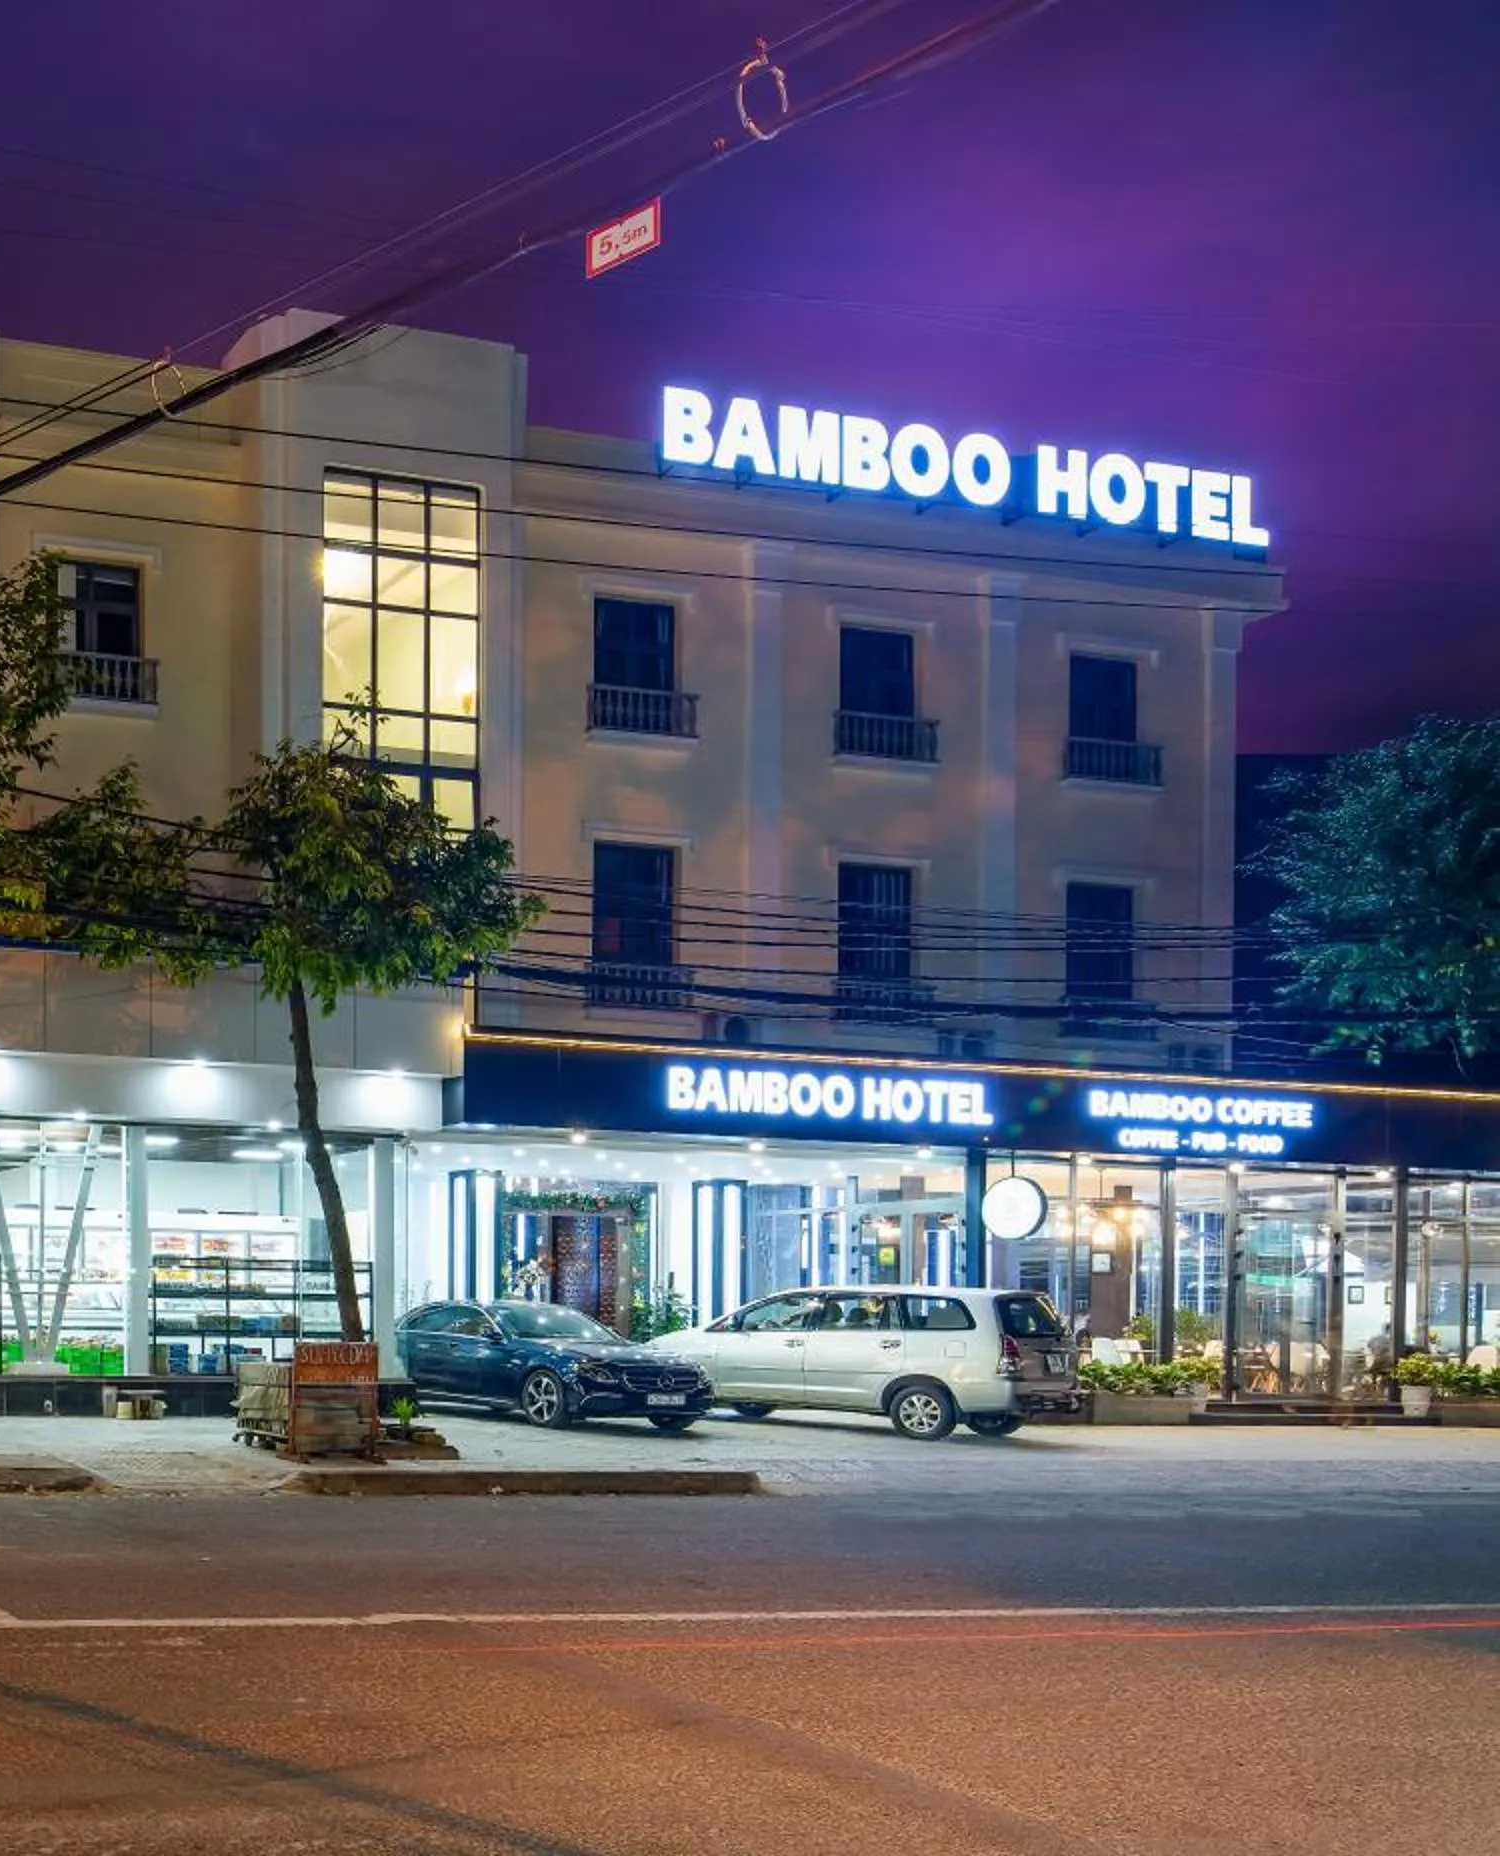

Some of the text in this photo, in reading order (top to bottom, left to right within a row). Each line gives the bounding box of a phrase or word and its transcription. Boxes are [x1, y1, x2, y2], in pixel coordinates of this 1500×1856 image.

[663, 386, 1269, 547] BAMBOO HOTEL
[667, 1065, 994, 1126] BAMBOO HOTEL
[1088, 1089, 1313, 1128] BAMBOO COFFEE
[1118, 1128, 1179, 1149] COFFEE
